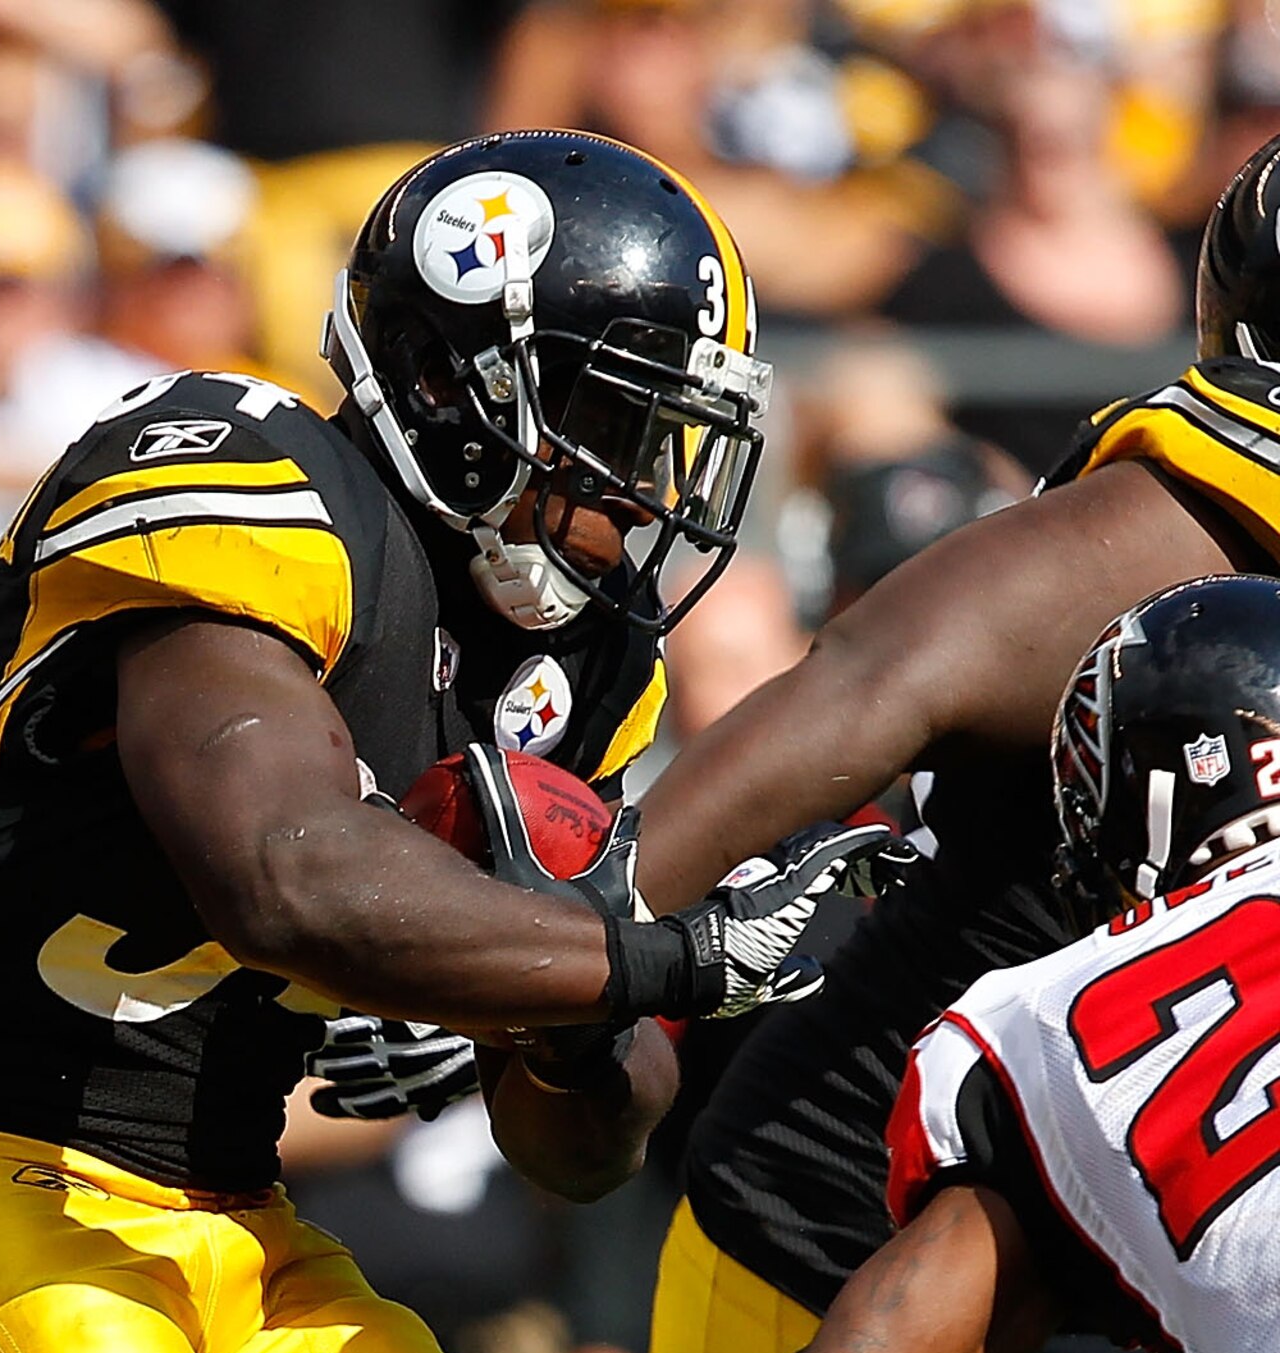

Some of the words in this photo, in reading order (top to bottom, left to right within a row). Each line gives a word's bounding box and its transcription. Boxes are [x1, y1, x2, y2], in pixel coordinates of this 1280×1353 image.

[437, 209, 477, 233] Steelers
[1193, 756, 1225, 778] NFL
[1067, 895, 1280, 1263] 2
